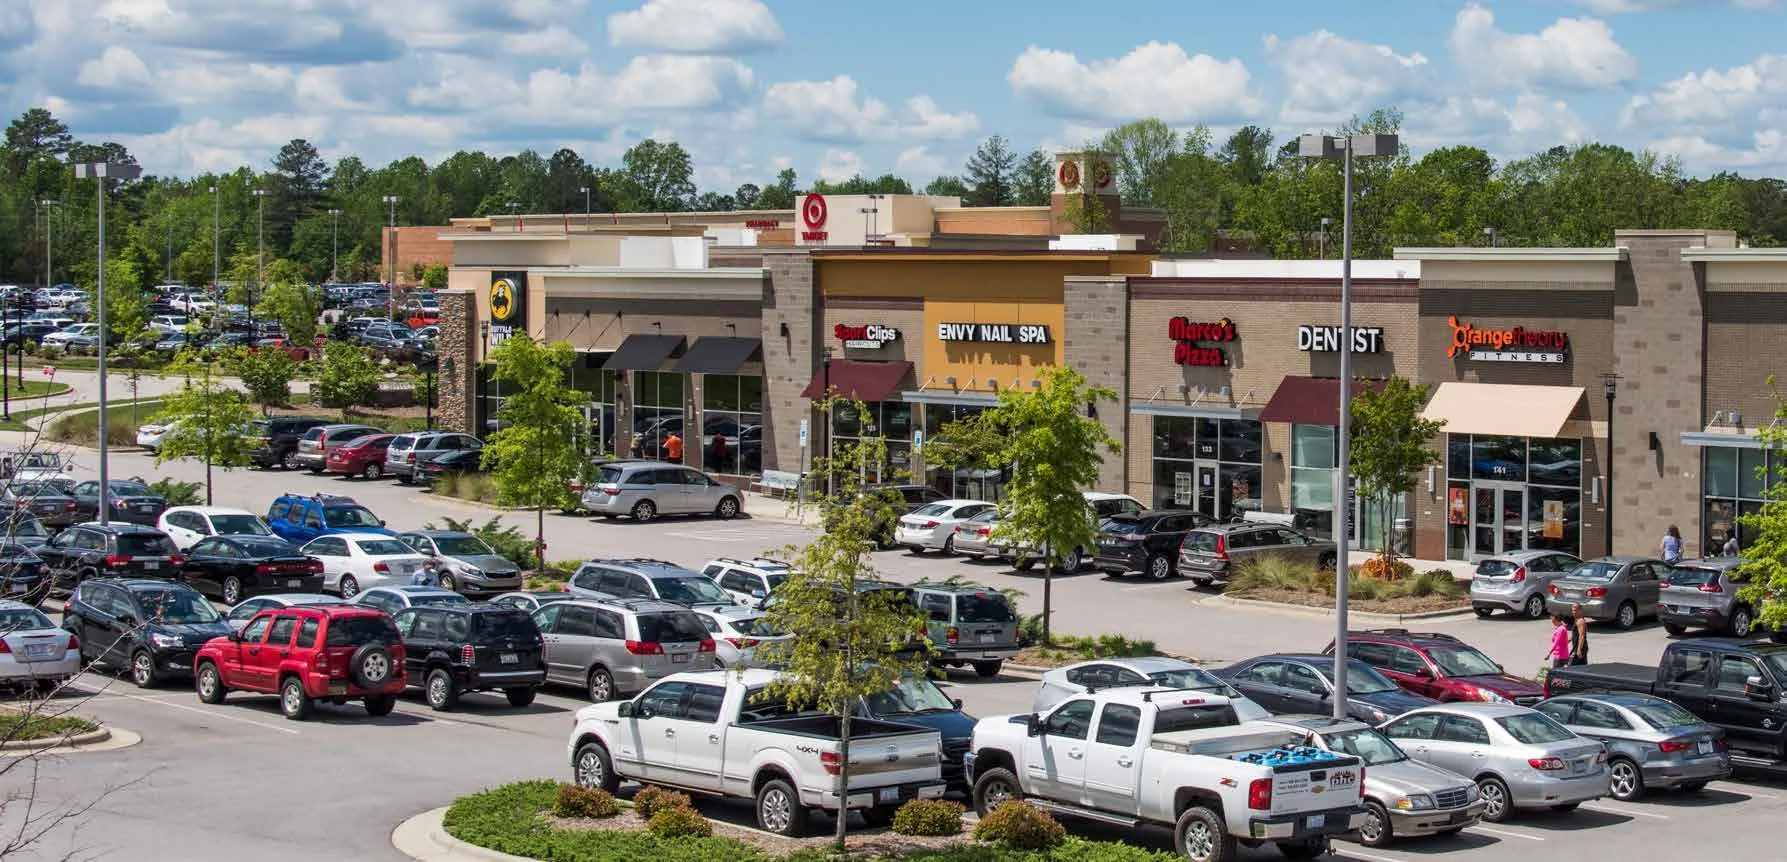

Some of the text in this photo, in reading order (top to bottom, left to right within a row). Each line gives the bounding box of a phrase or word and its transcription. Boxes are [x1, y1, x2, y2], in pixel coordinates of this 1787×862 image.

[801, 232, 828, 241] TARGET
[938, 323, 1046, 342] ENVY NAIL SPA
[1169, 316, 1234, 341] Marco's
[1449, 319, 1566, 352] Orangetheory
[1174, 342, 1221, 366] Pizza
[1469, 352, 1563, 361] FITNESS
